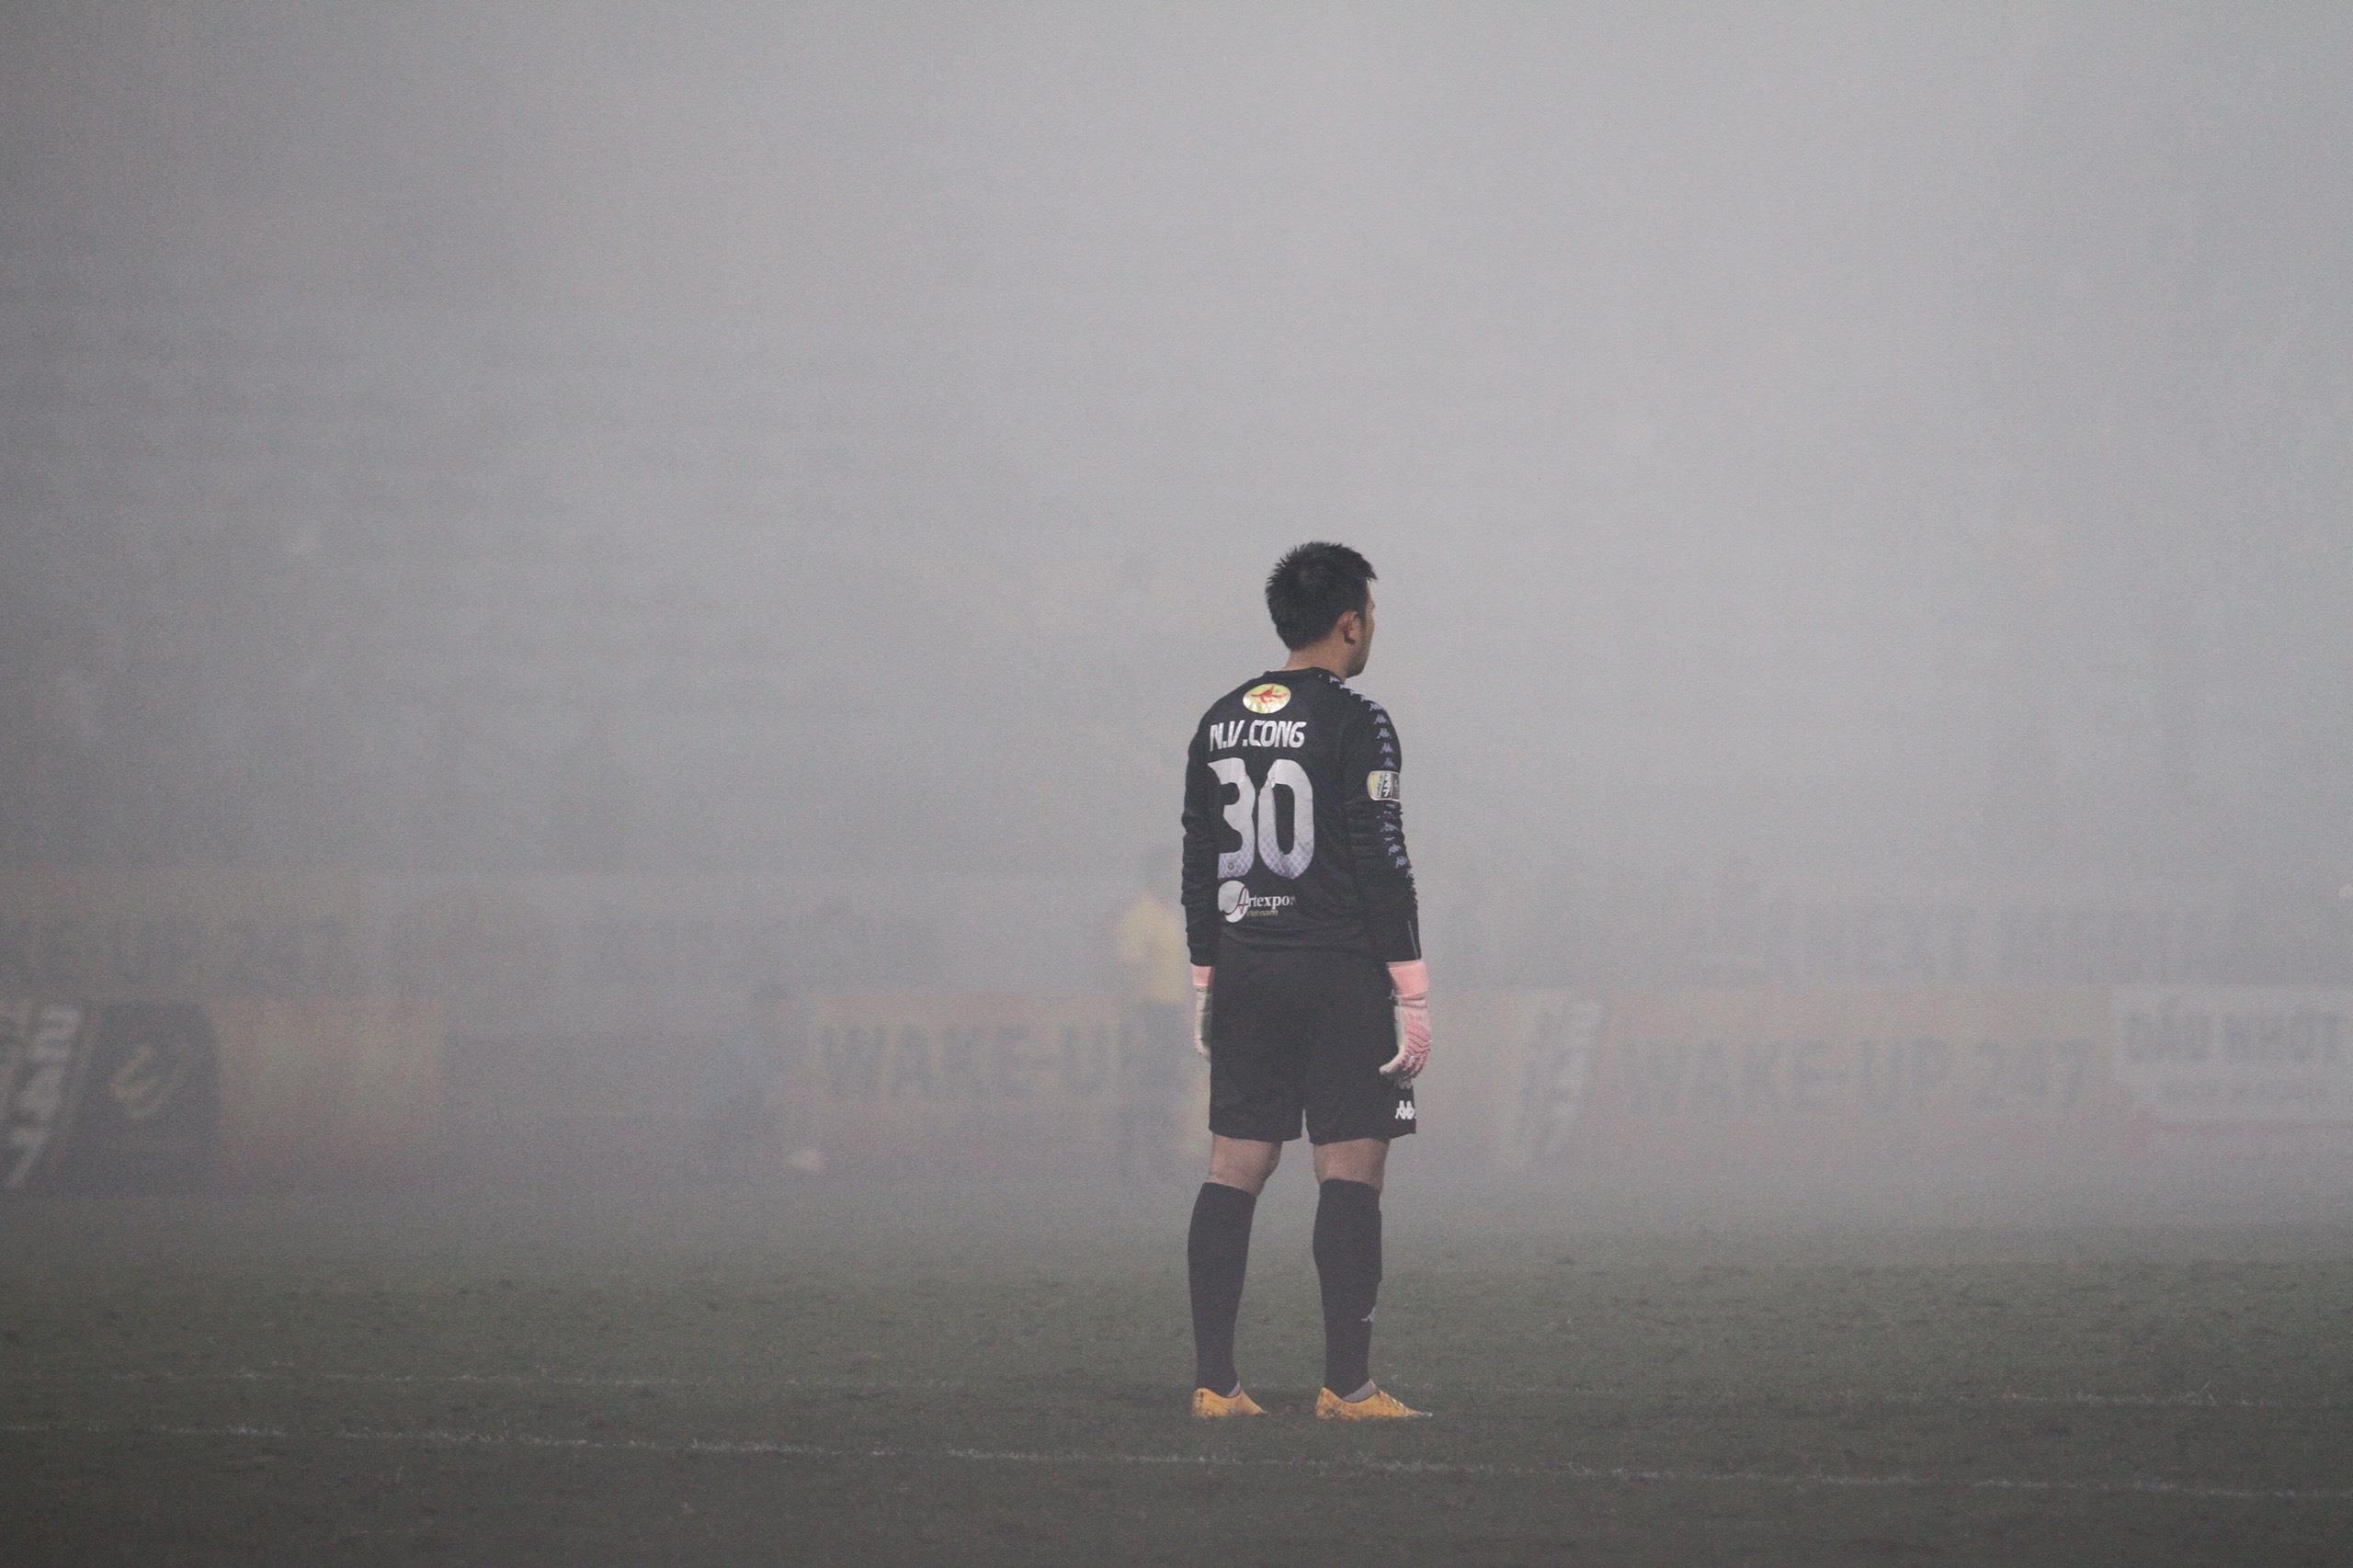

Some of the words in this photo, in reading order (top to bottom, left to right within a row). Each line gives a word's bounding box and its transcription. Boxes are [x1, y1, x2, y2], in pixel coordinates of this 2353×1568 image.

[1209, 719, 1307, 752] N.V.CONG
[1207, 757, 1314, 880] 30
[1220, 886, 1295, 915] Artexpo
